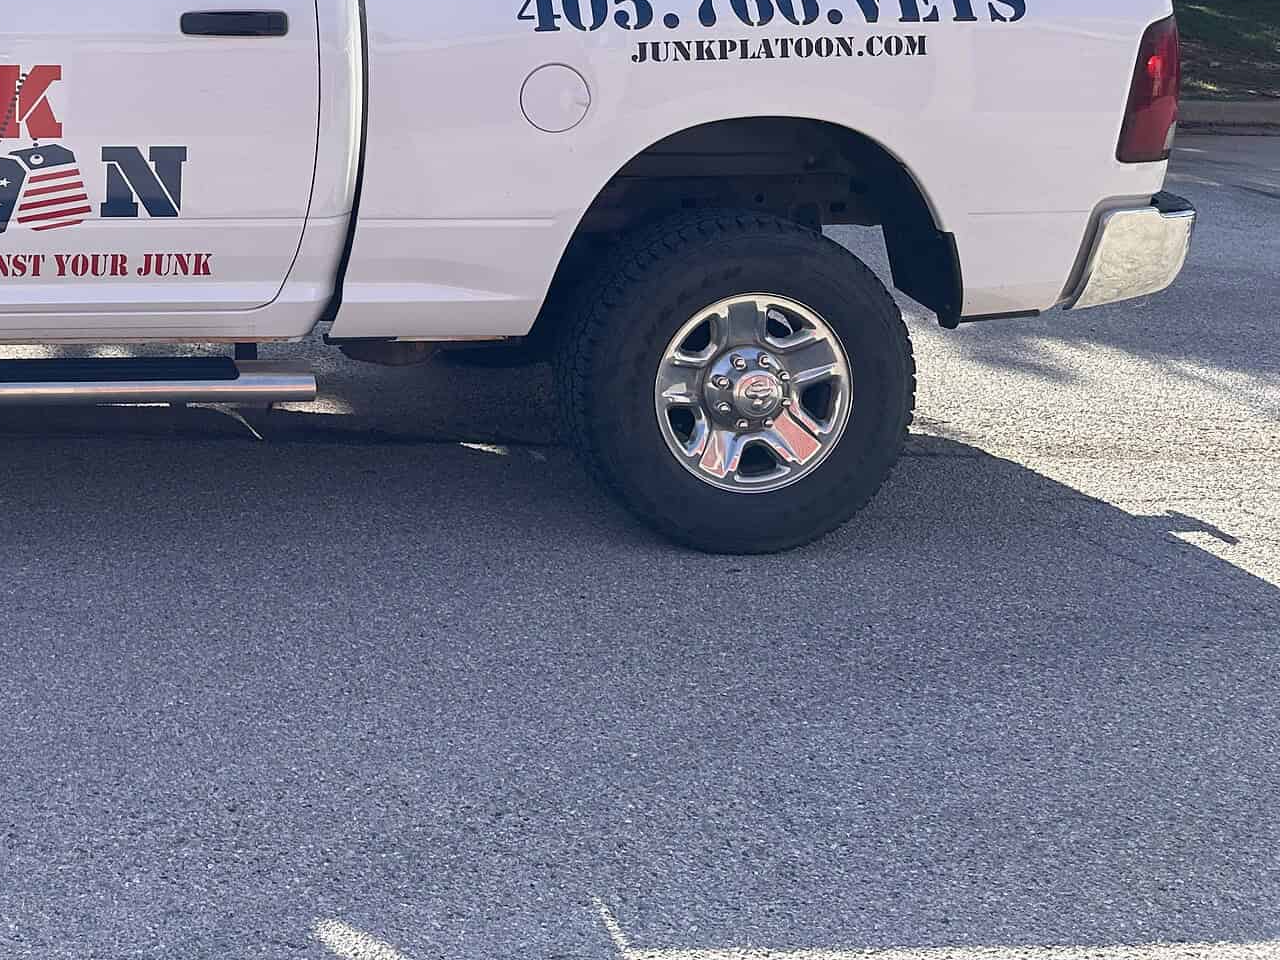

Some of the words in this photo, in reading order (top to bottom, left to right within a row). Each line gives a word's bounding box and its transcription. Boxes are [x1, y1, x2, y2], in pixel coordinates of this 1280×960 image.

[631, 35, 927, 63] JUNKPLATOON.COM
[53, 253, 129, 277] YOUR
[136, 253, 213, 277] JUNK
